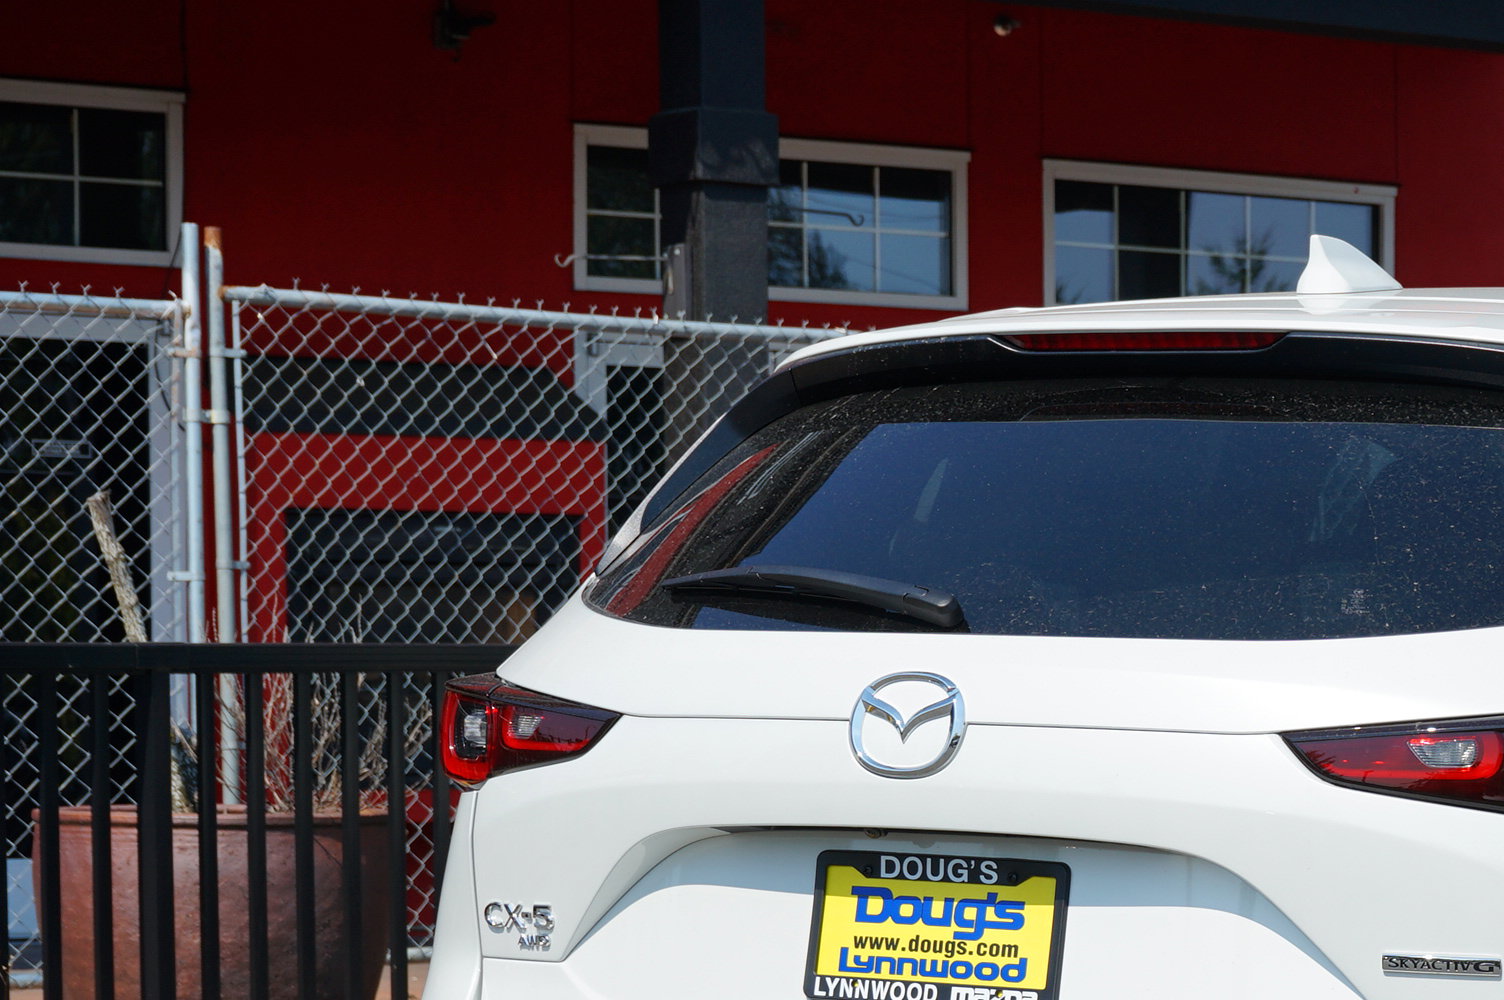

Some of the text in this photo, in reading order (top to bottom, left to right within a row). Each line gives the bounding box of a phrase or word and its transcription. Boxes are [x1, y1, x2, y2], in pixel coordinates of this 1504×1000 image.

[880, 855, 999, 885] DOUG'S
[484, 902, 555, 931] CX-5
[853, 934, 1019, 958] www.dougs.com
[838, 947, 1028, 983] Lynnwood
